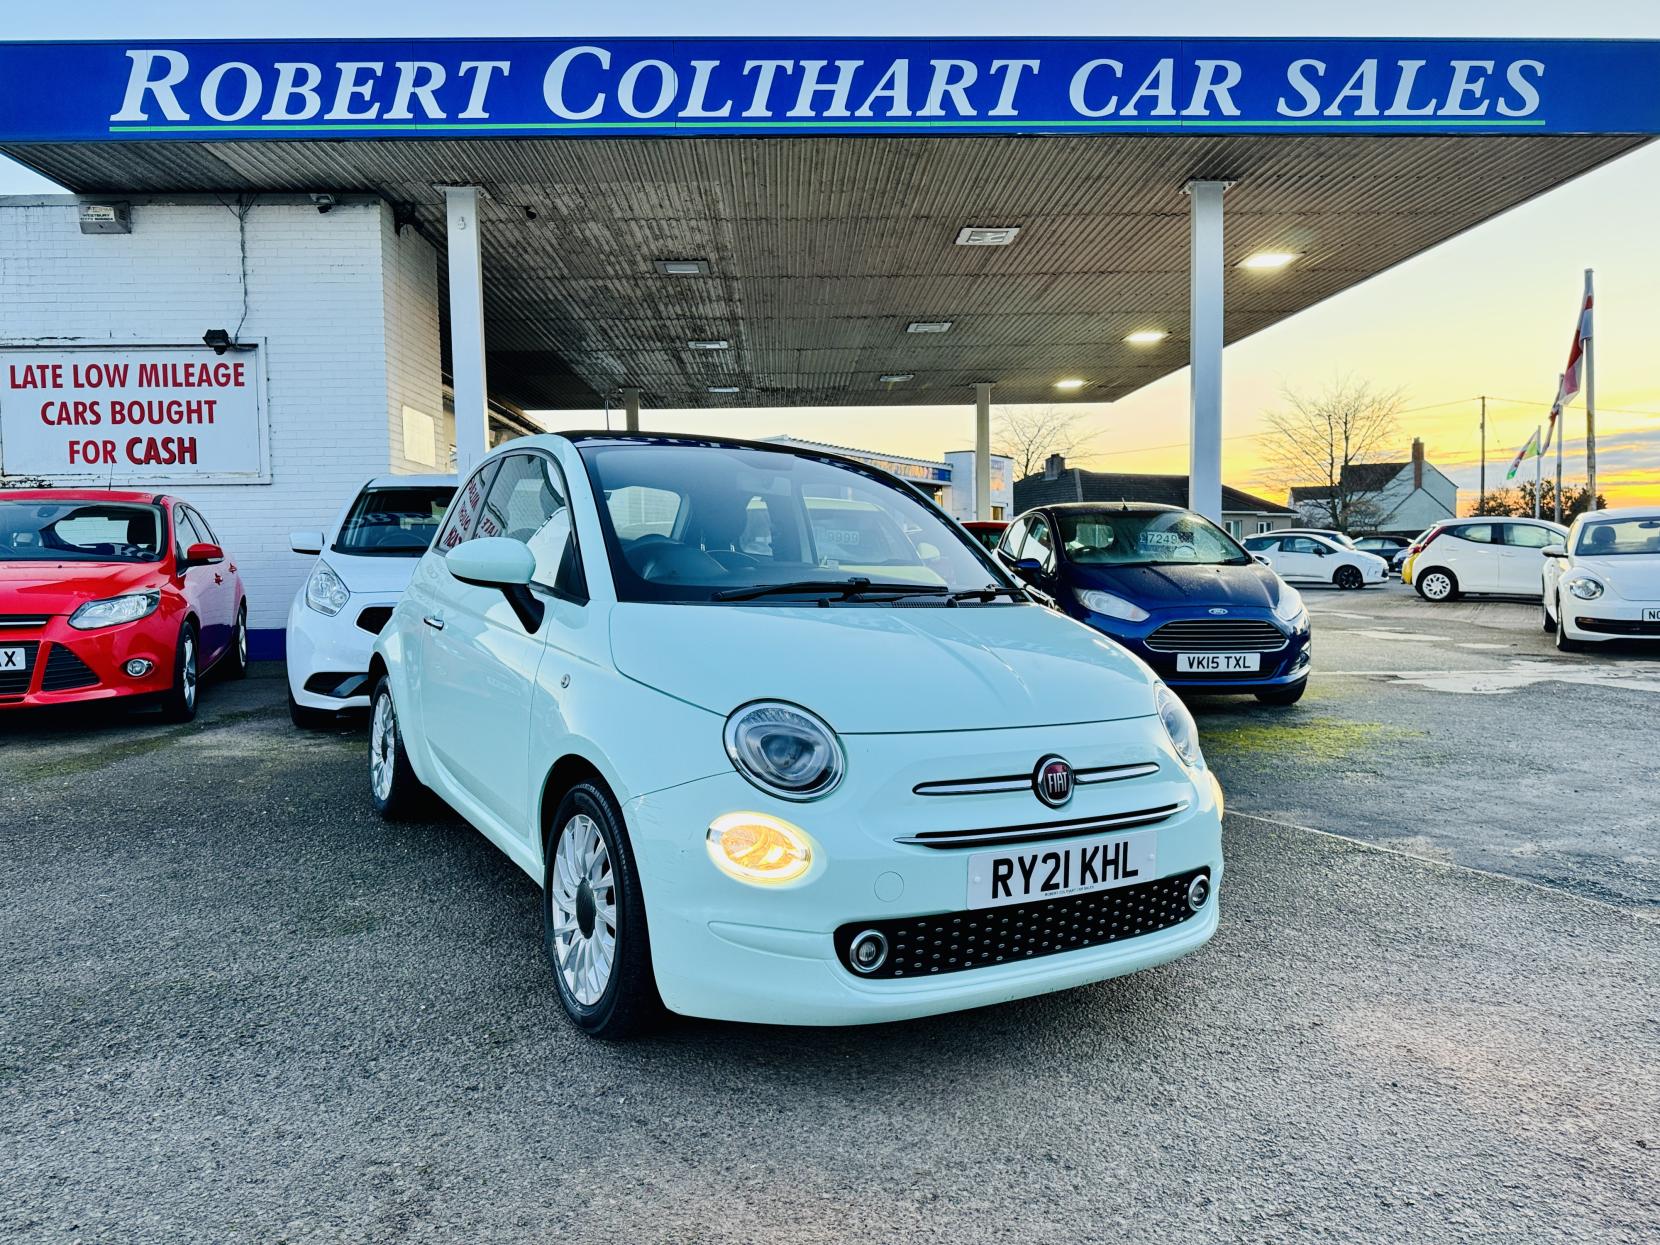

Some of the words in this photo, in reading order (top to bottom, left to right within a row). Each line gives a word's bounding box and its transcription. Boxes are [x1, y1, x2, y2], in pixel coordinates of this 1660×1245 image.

[109, 48, 511, 121] ROBERT
[542, 45, 1041, 120] COLTHART
[1069, 58, 1242, 117] CAR
[1276, 58, 1546, 117] SALES
[9, 364, 64, 389] LATE
[73, 363, 129, 388] LOW
[138, 362, 246, 388] MILEAGE
[41, 401, 102, 426] CARS
[110, 399, 218, 425] BOUGHT
[68, 440, 117, 465] FOR
[125, 436, 198, 465] CASH
[1187, 655, 1220, 670] VK15
[1224, 655, 1252, 669] TXL
[1047, 771, 1068, 793] FIAT
[991, 849, 1071, 900] RY21
[1079, 840, 1139, 887] KHL
